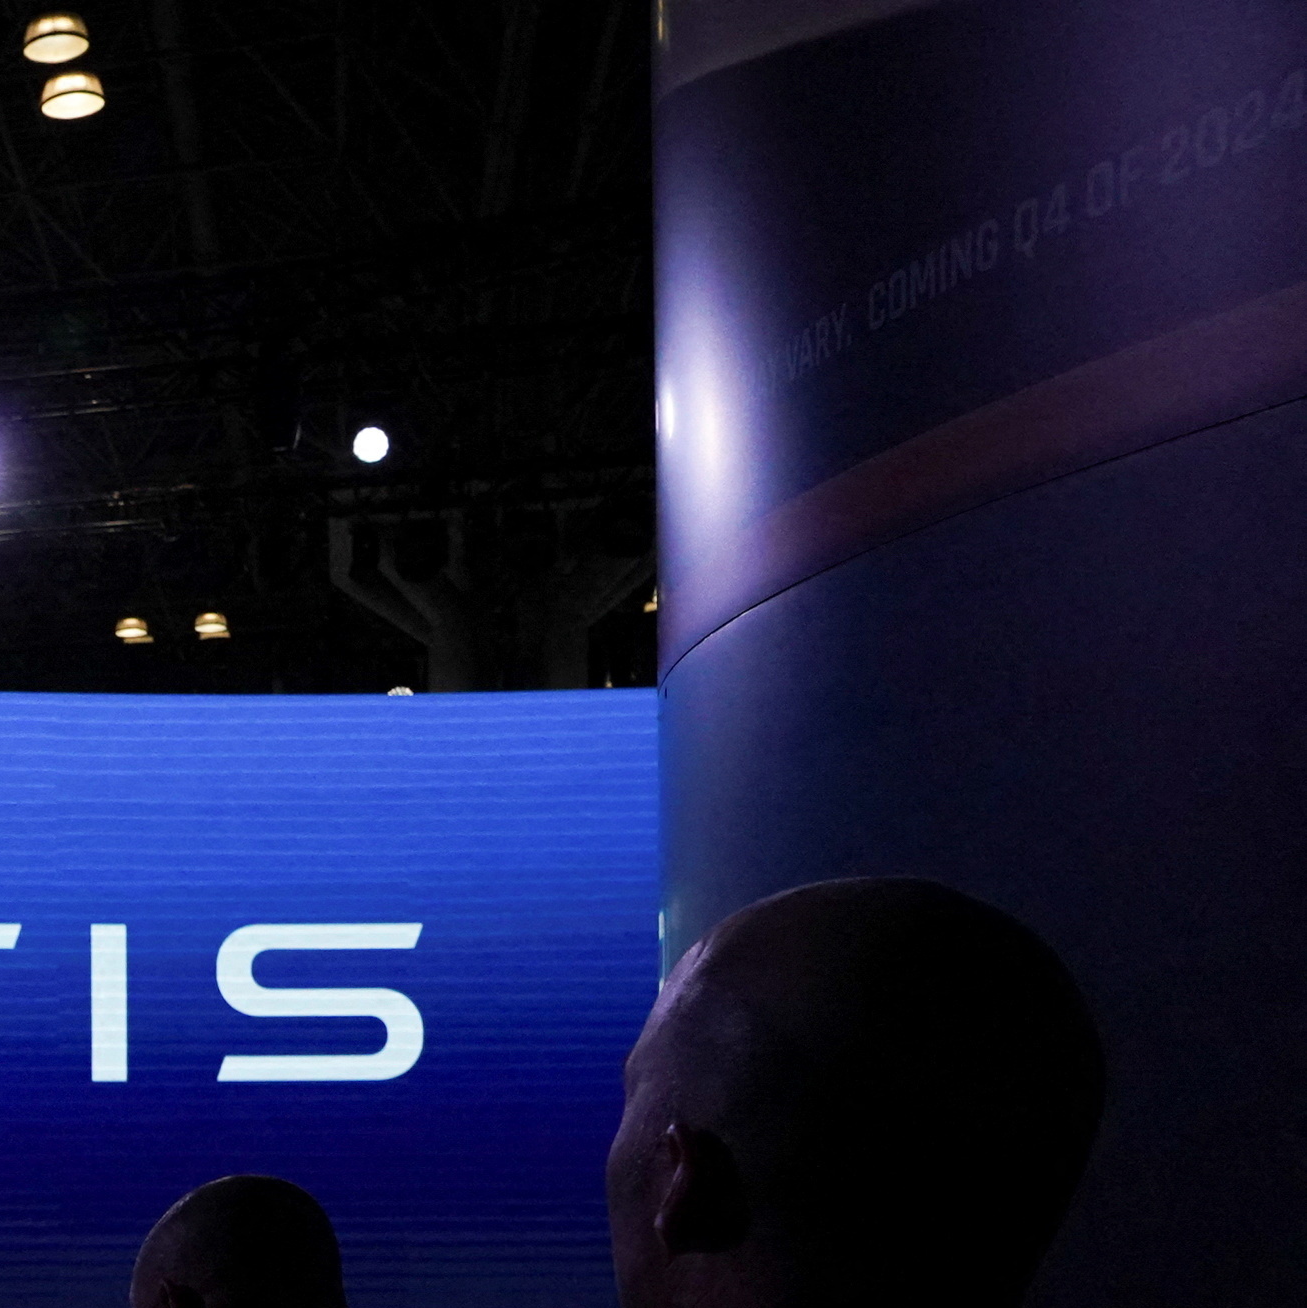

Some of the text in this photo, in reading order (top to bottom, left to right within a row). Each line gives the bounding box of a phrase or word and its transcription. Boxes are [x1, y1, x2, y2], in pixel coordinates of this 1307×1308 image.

[867, 218, 1001, 330] COMING
[1014, 182, 1070, 258] Q4
[1086, 145, 1148, 217] OF
[1159, 69, 1307, 185] 2024
